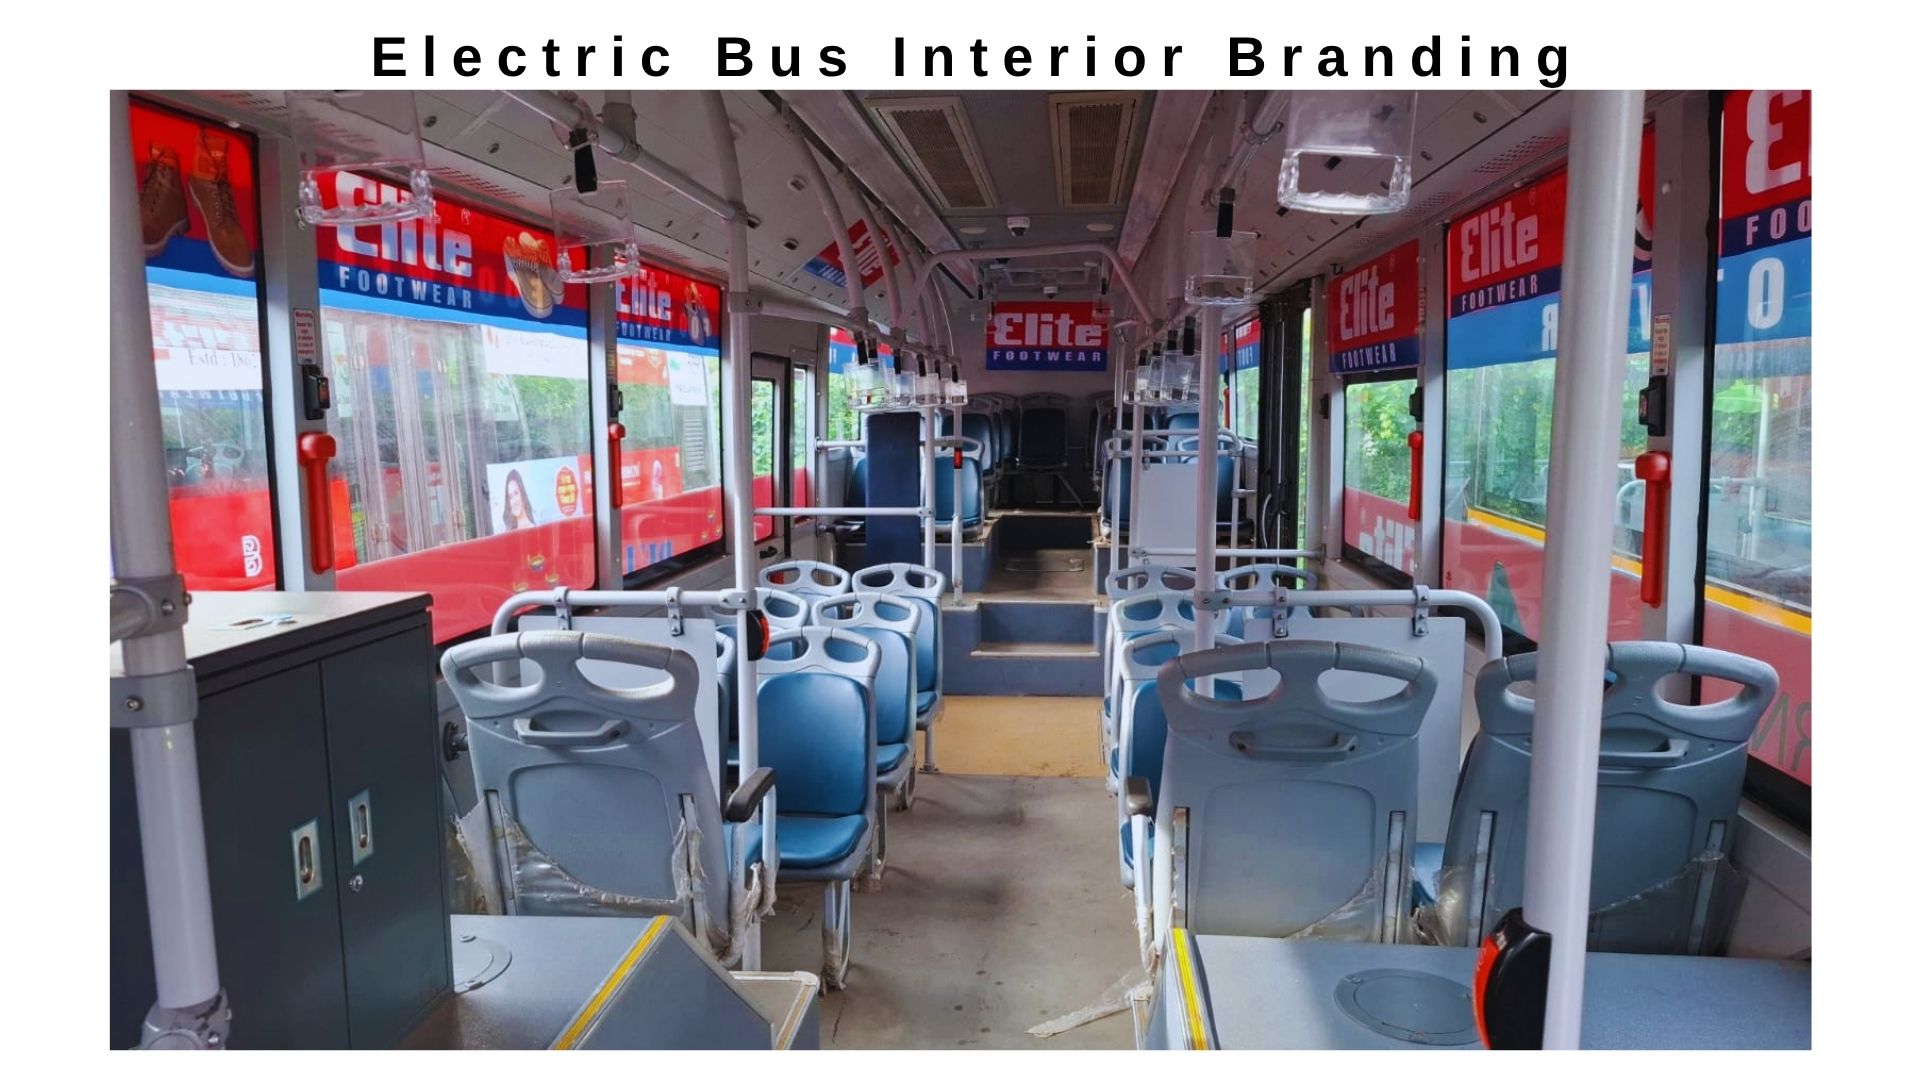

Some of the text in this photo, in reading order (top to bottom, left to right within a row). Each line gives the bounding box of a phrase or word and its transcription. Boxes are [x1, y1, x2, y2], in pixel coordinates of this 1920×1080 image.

[335, 171, 473, 278] Elite
[1461, 201, 1538, 283] Elite
[339, 265, 472, 309] FOOTWEAR
[1341, 264, 1394, 340] Elite
[1462, 274, 1538, 312] FOOTWEAR
[993, 312, 1102, 346] Elite
[993, 350, 1101, 362] FOOTWEAR
[1342, 342, 1396, 369] FOOTWEAR
